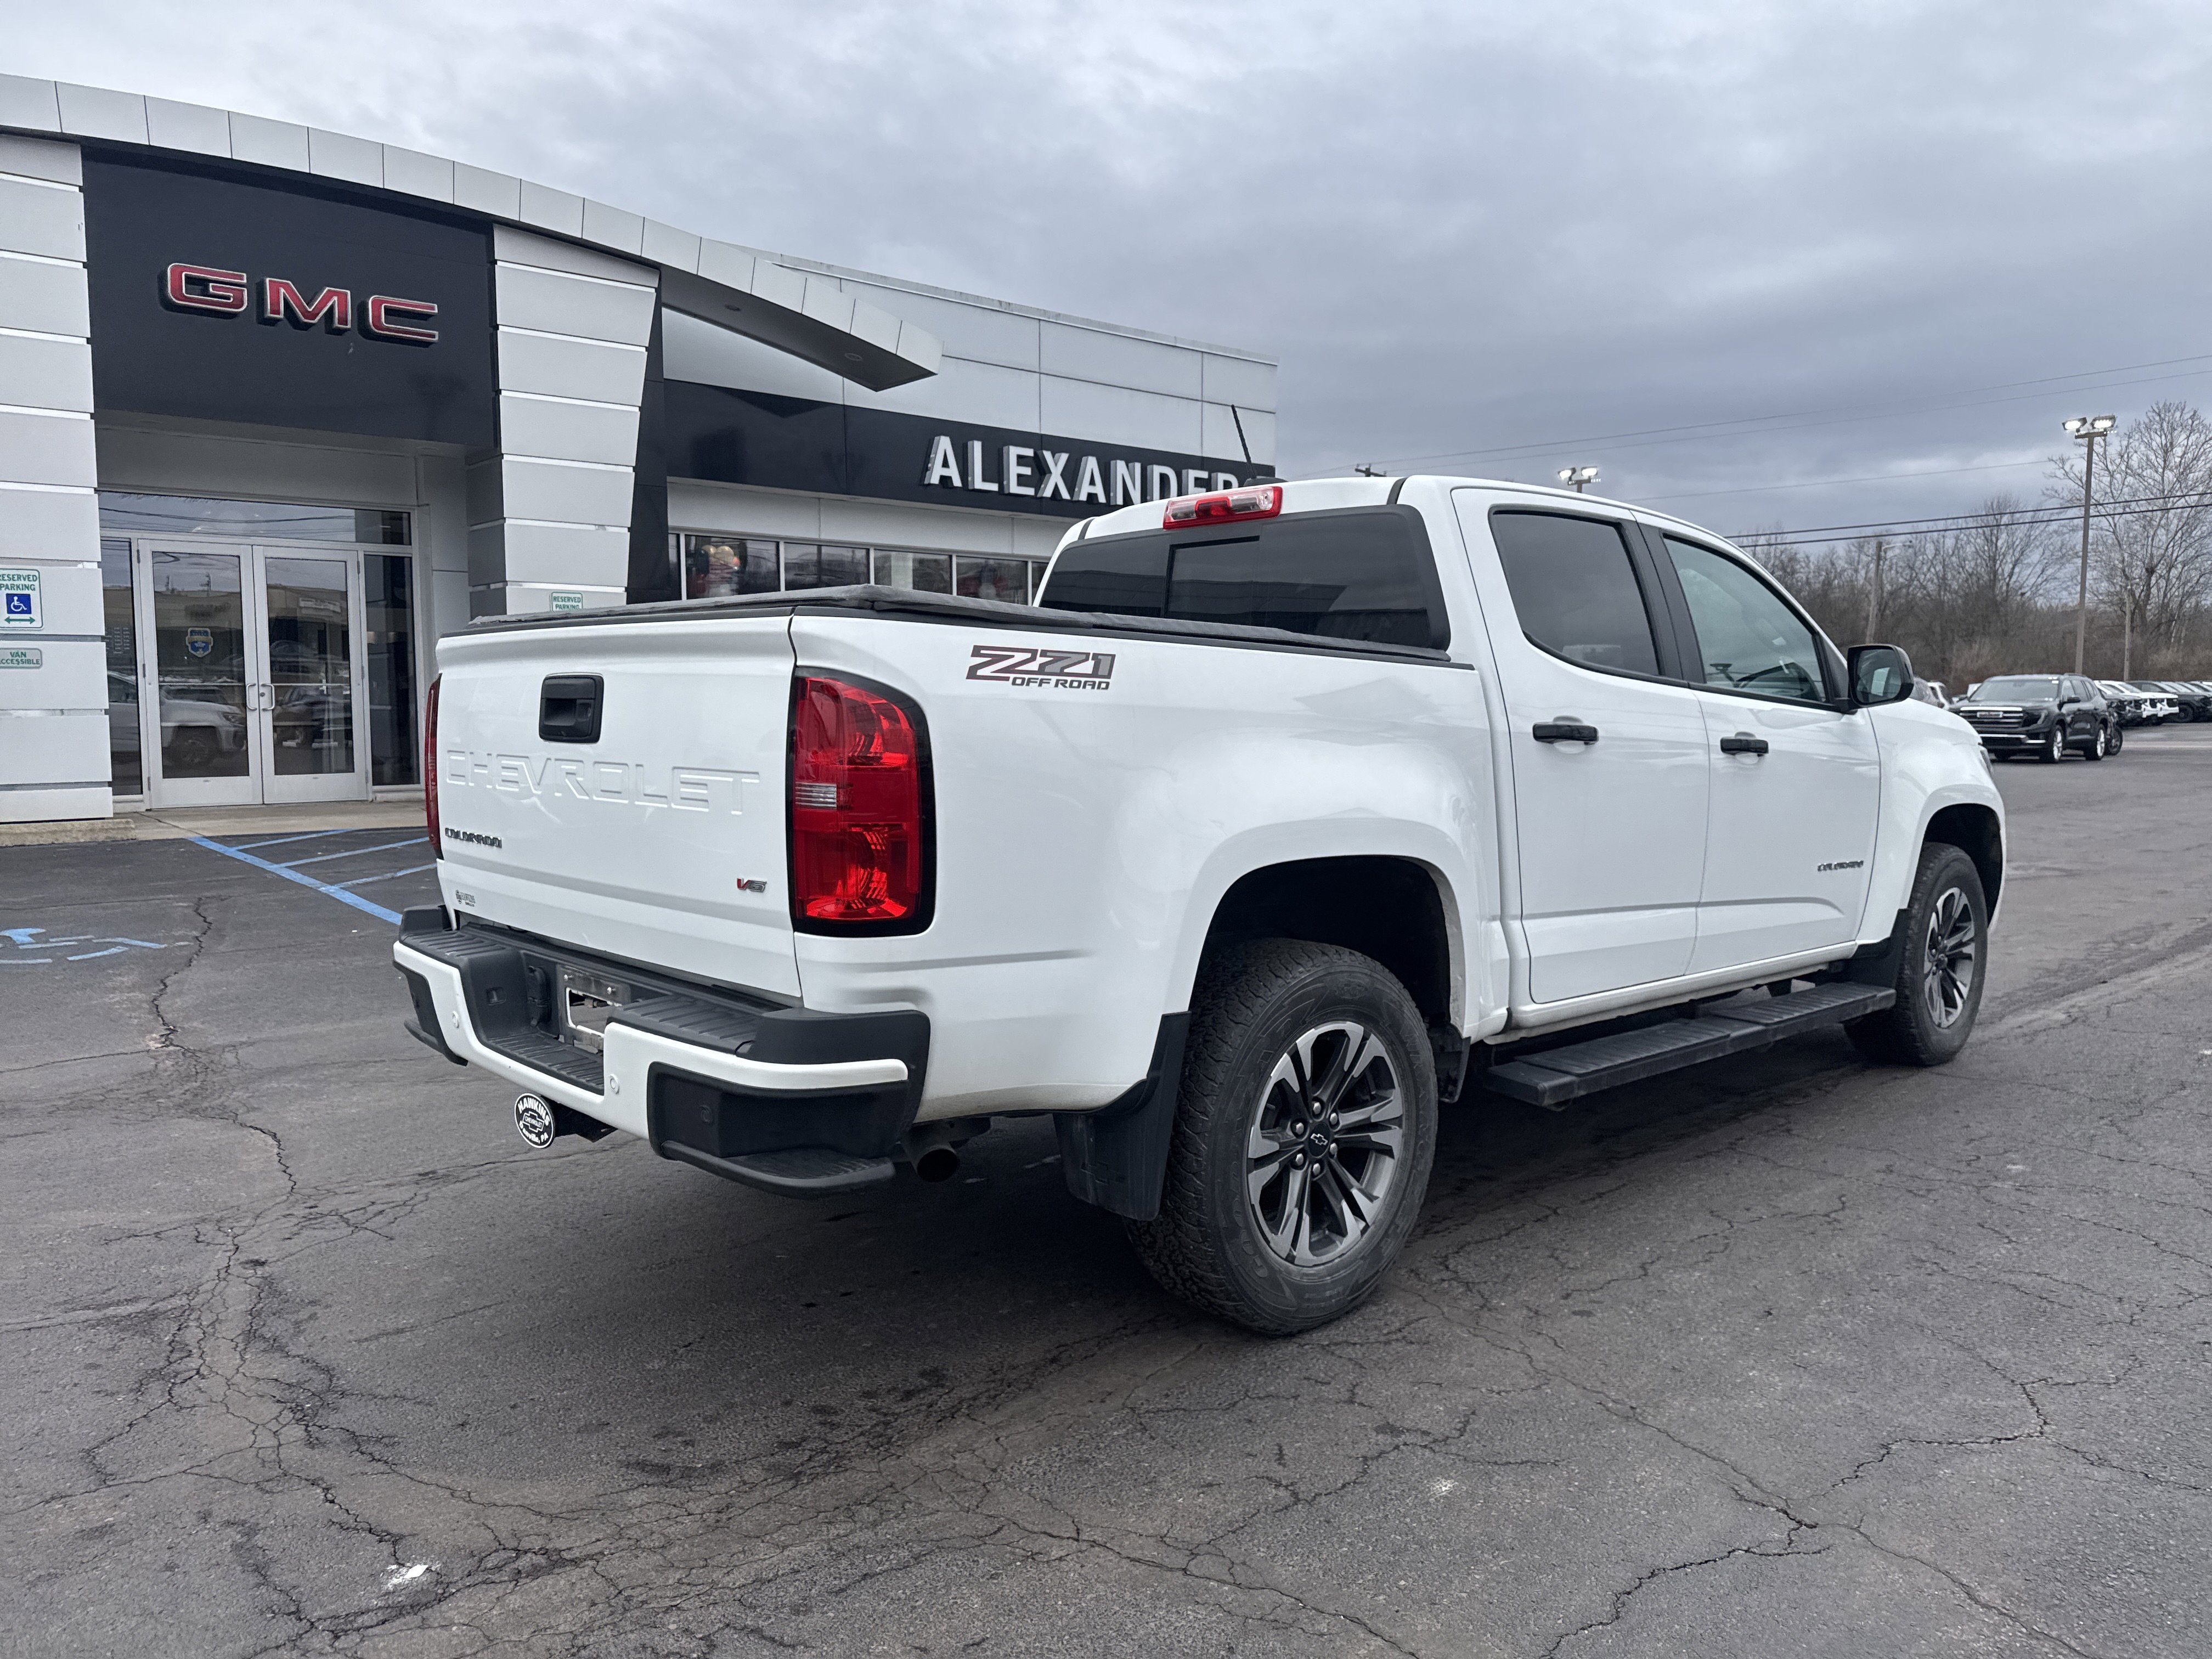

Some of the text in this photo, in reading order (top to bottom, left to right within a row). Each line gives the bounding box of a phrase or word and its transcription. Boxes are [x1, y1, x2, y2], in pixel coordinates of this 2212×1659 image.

[167, 263, 438, 342] GMC
[0, 574, 38, 582] ESERVED
[0, 583, 36, 591] PARKING
[966, 645, 1116, 681] Z71
[1012, 676, 1110, 690] OFF ROAD
[447, 749, 760, 815] CHEVROLET
[445, 827, 502, 848] COLORADO
[737, 878, 767, 893] V6
[518, 1098, 550, 1126] HAWKINS
[541, 1132, 548, 1142] PA
